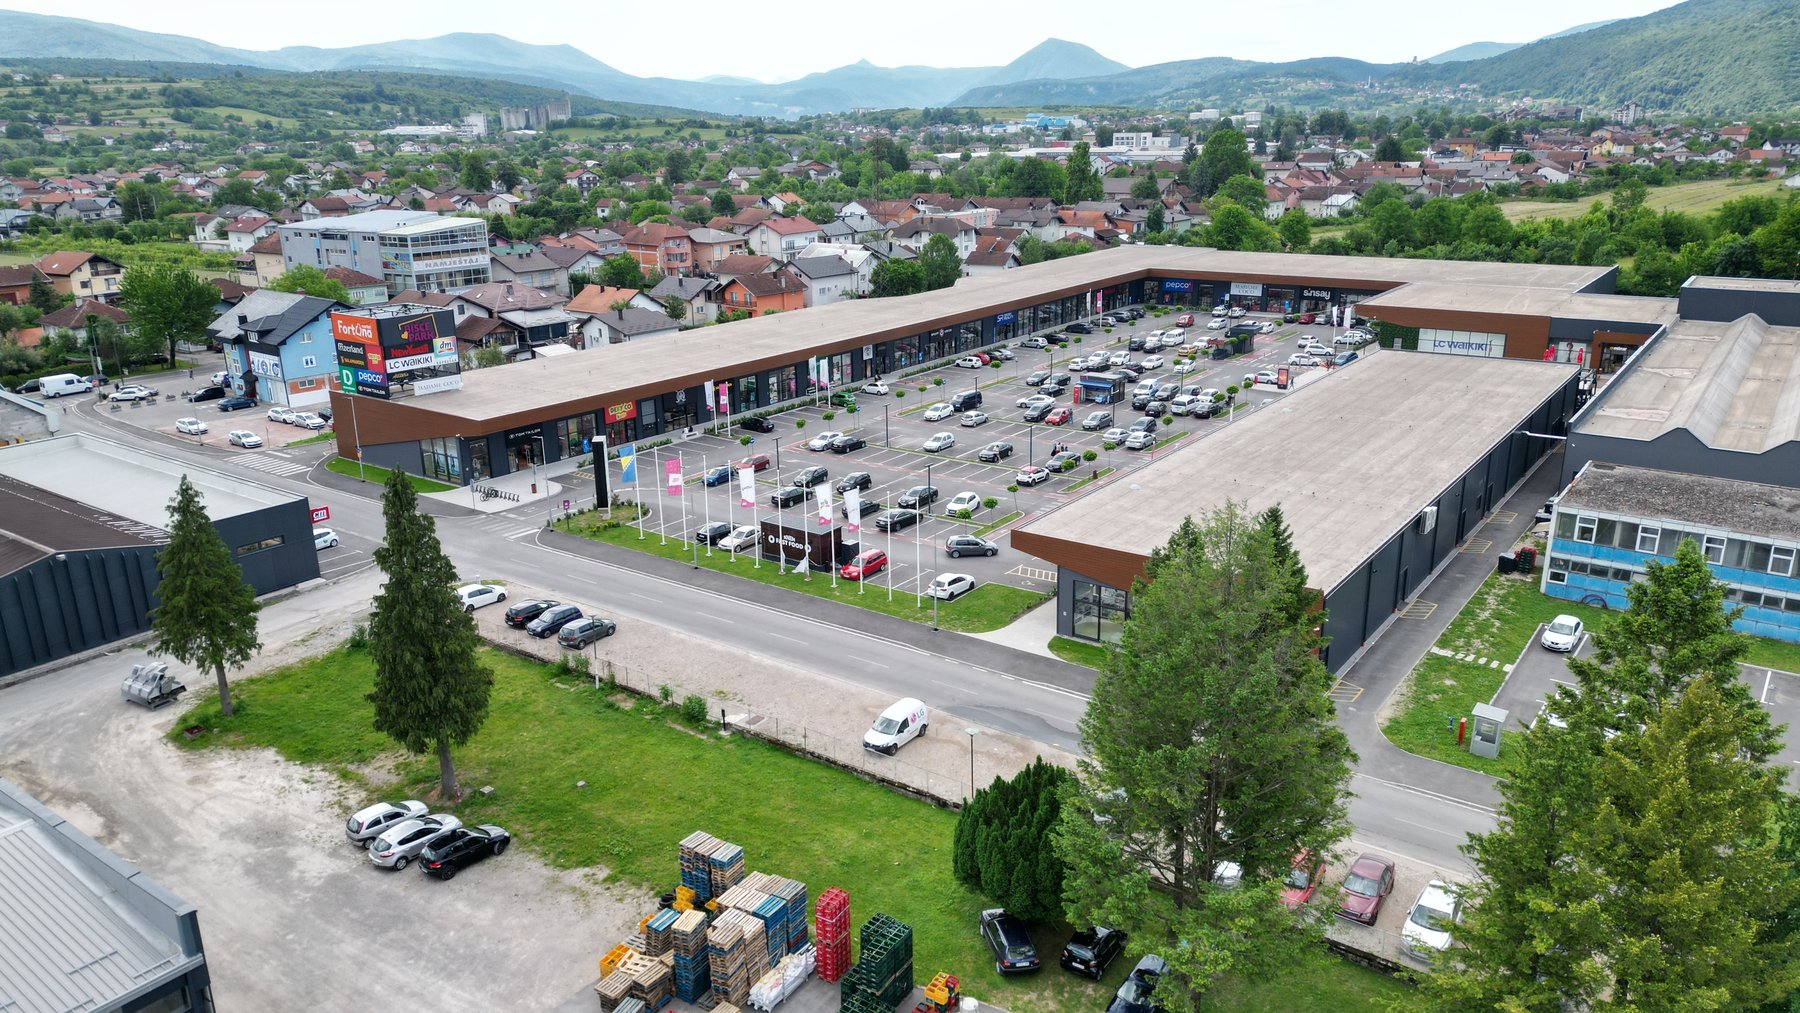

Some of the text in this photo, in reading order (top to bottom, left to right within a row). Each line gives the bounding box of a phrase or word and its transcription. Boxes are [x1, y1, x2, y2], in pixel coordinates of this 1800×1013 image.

[1165, 281, 1189, 289] pepco
[1303, 288, 1331, 300] sinsay
[337, 319, 373, 338] Fortuna
[408, 331, 435, 342] PARK
[440, 341, 452, 349] dm
[1433, 340, 1446, 349] LC
[389, 360, 400, 370] LC
[342, 369, 353, 385] D
[358, 371, 382, 383] pepco
[788, 541, 804, 550] FOOD
[916, 708, 925, 719] LG
